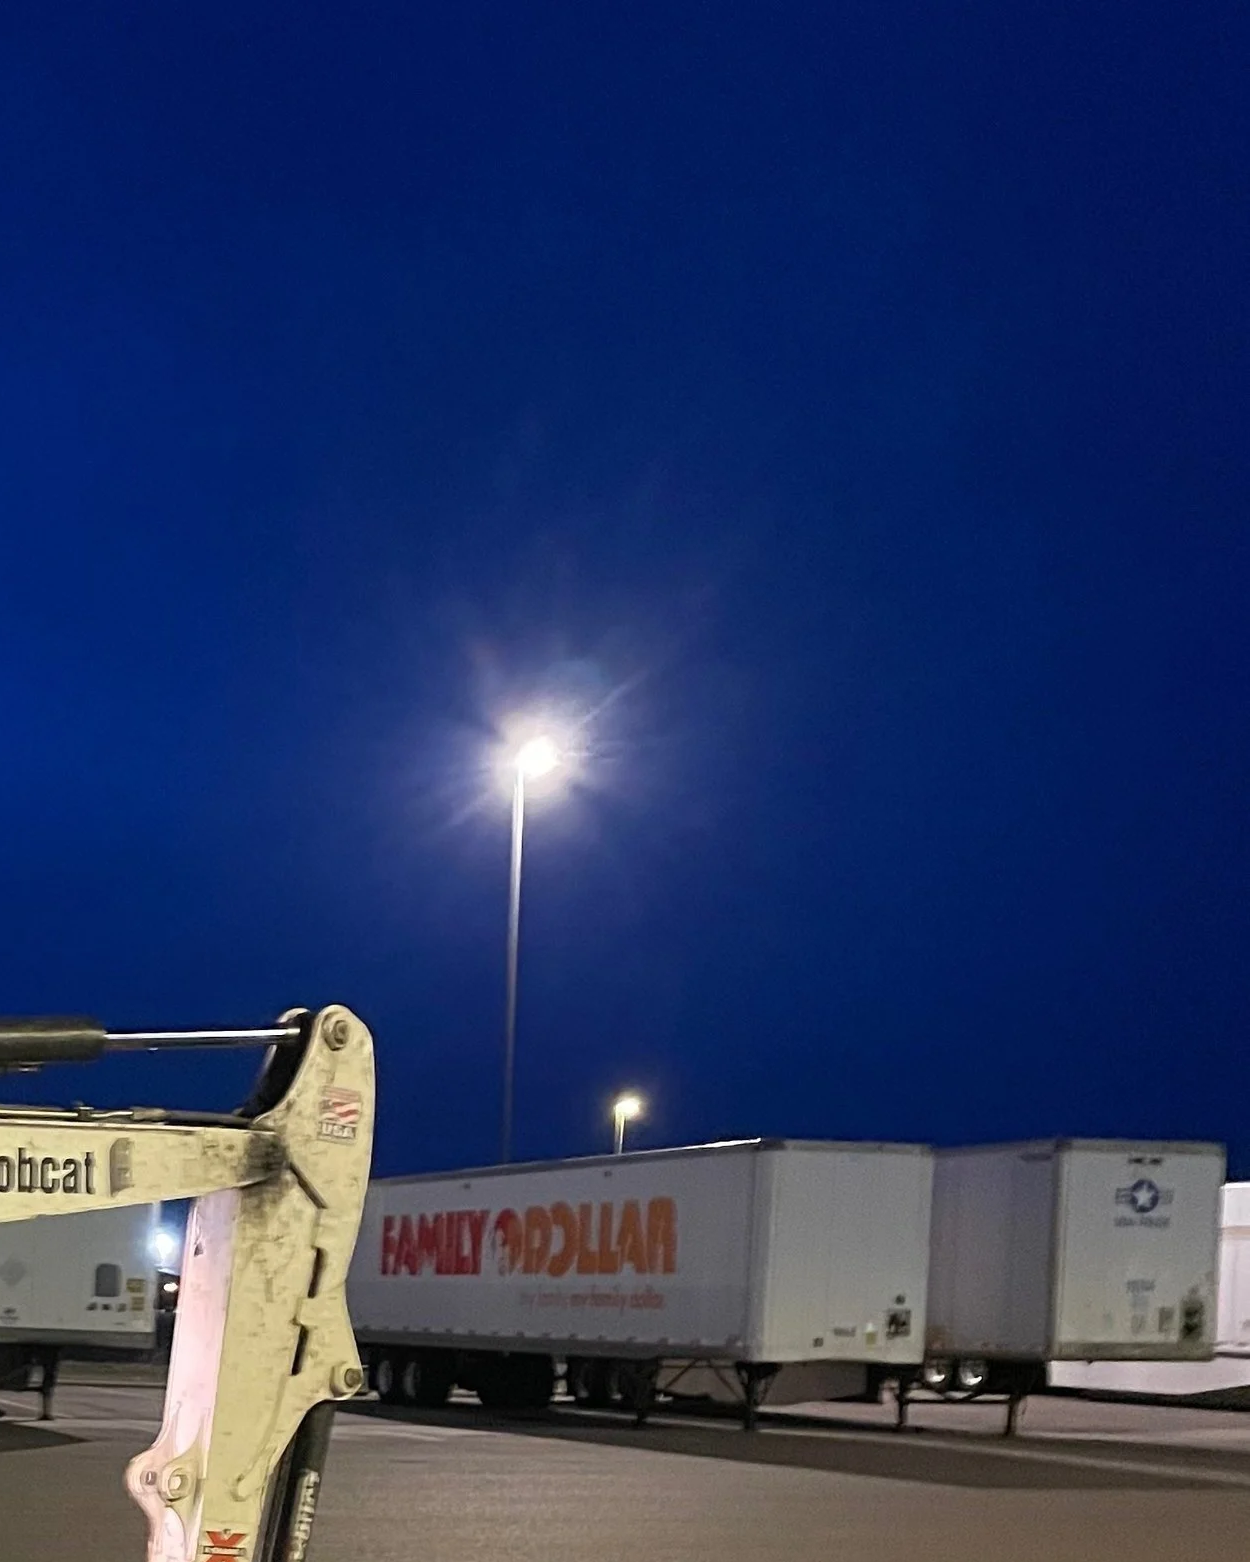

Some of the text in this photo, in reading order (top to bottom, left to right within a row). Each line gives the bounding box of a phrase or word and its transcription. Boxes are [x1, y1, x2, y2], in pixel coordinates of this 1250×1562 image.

[321, 1122, 354, 1139] USA
[381, 1196, 678, 1277] FAMILY DOLLAR
